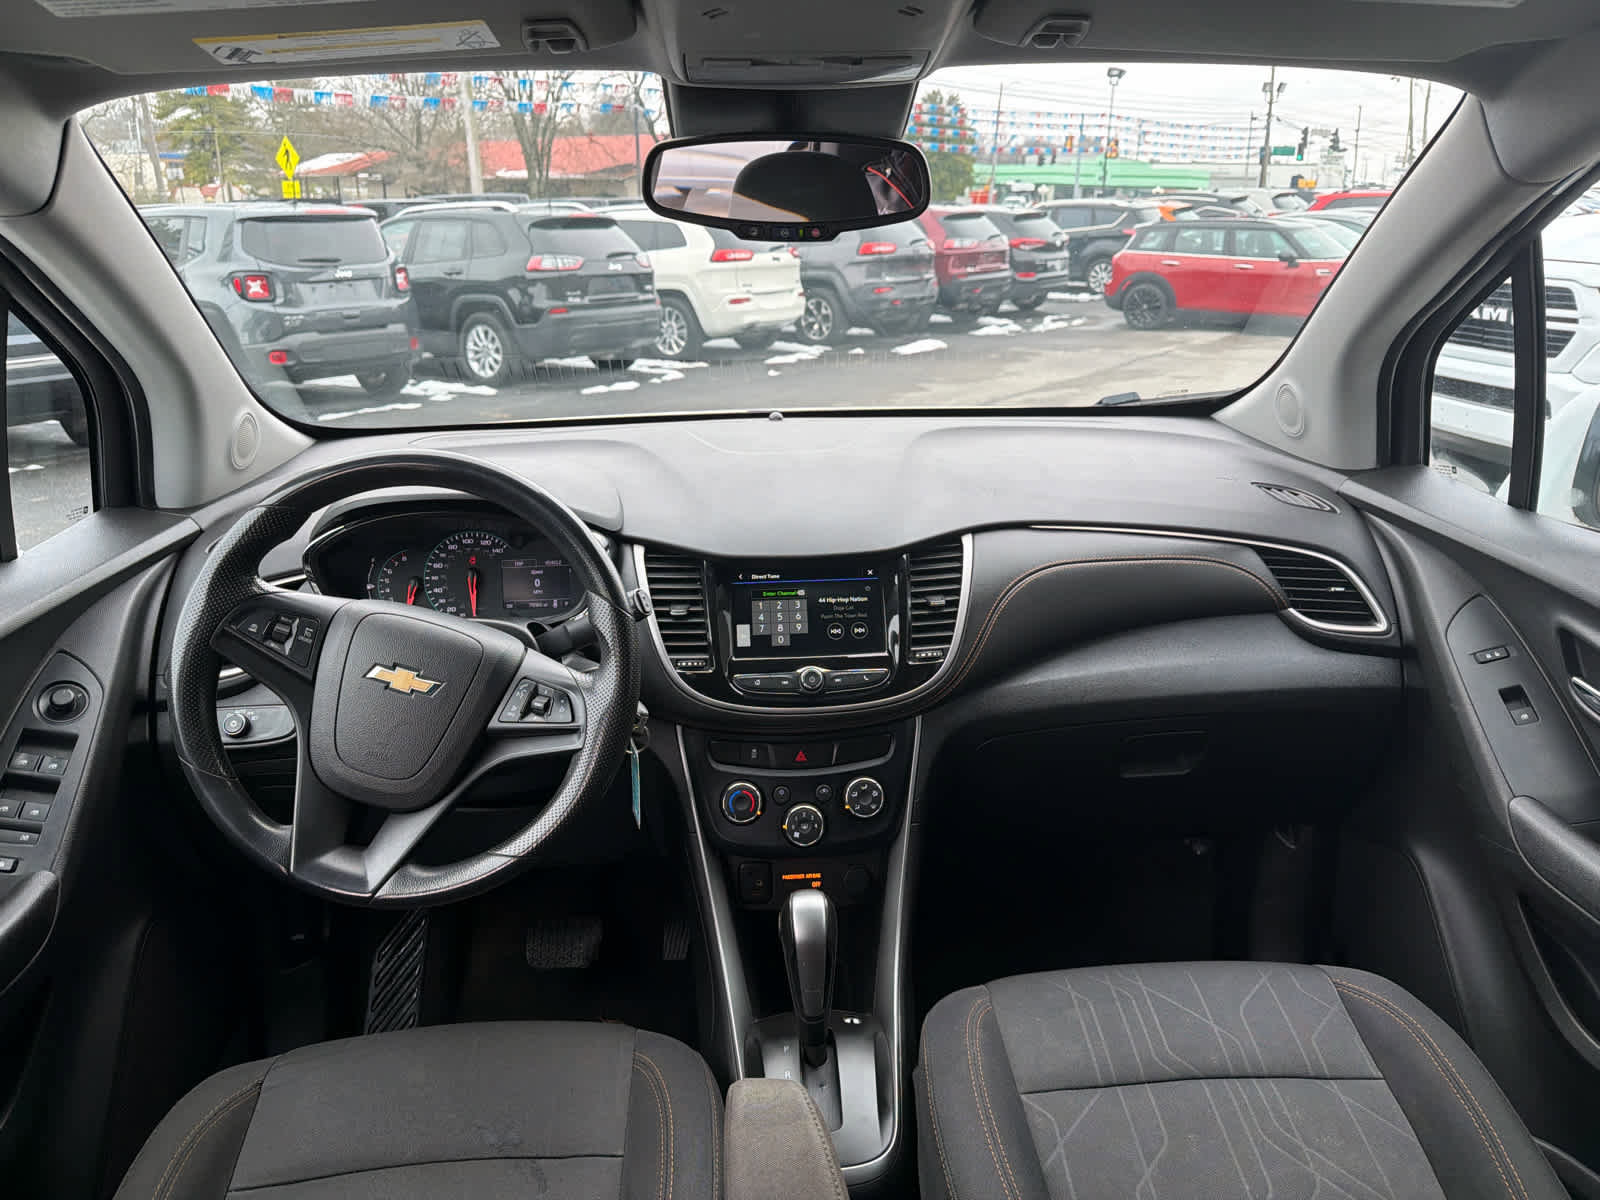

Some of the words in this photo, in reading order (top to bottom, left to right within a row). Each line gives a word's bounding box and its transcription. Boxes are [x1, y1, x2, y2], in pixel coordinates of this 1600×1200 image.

[1470, 305, 1508, 322] AM
[759, 601, 764, 610] 1
[777, 601, 783, 609] 2
[795, 601, 801, 609] 3
[758, 613, 764, 621] 4
[777, 612, 783, 621] 5
[796, 613, 802, 621] 6
[759, 624, 765, 632] 7
[777, 624, 784, 632] 8
[796, 623, 802, 631] 9
[778, 636, 784, 644] 0
[811, 880, 822, 888] OFF
